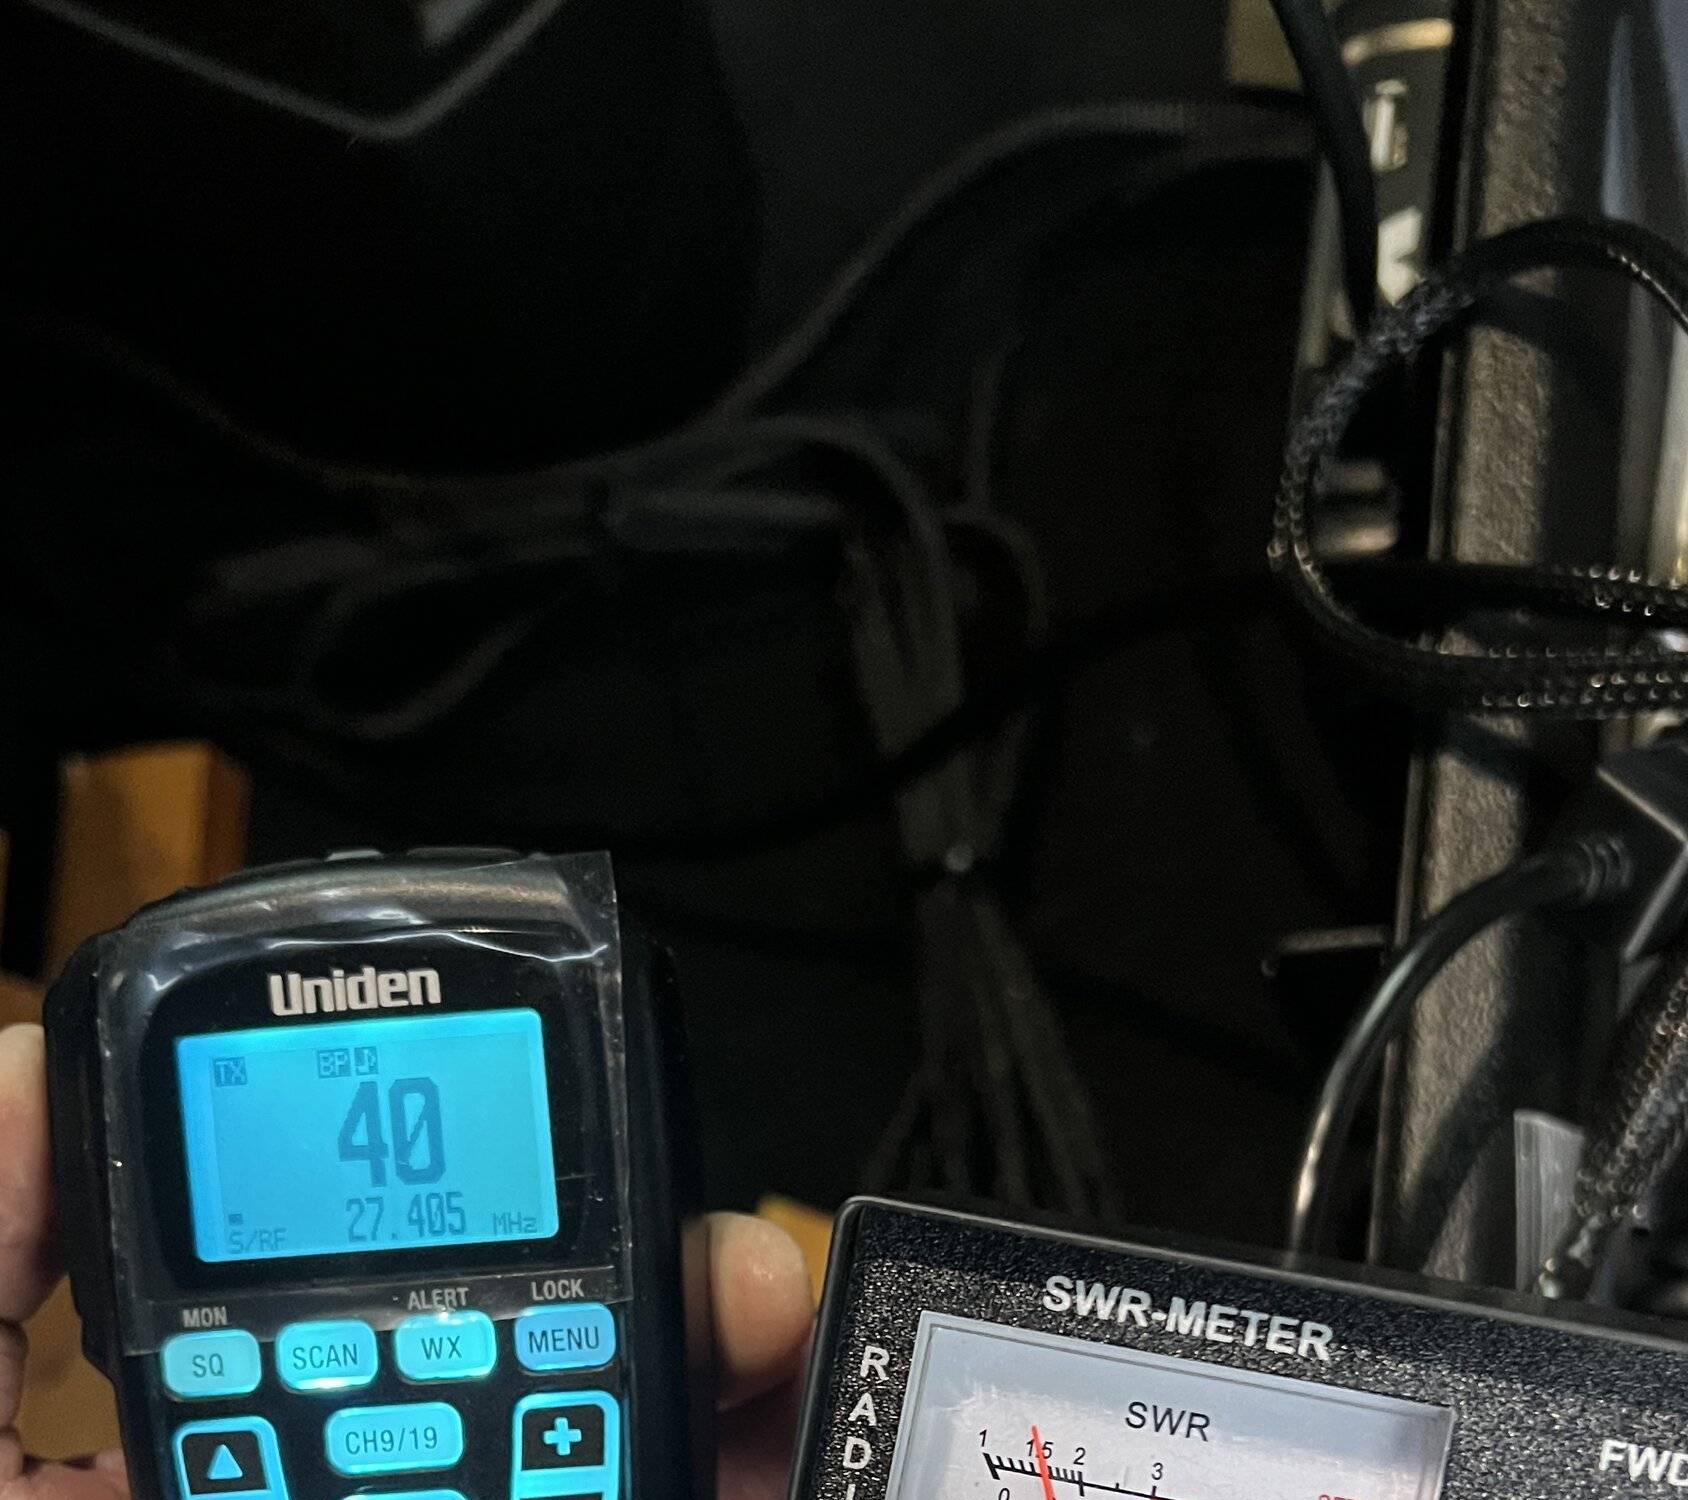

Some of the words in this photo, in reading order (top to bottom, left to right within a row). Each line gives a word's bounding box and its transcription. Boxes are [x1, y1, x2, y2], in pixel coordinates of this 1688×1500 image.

[268, 966, 442, 1017] Uniden
[214, 1059, 247, 1087] TX
[318, 1050, 350, 1078] BP
[337, 1076, 446, 1188] 40
[345, 1191, 467, 1244] 27.405
[492, 1212, 539, 1236] MHz
[228, 1227, 287, 1255] S/RF
[407, 1287, 469, 1312] ALERT
[531, 1278, 585, 1301] LOCK
[182, 1305, 228, 1329] MON
[1043, 1275, 1335, 1362] SWR-METER
[420, 1336, 463, 1361] WX
[527, 1327, 601, 1354] MENU
[192, 1352, 225, 1379] SQ
[292, 1342, 359, 1371] SCAN
[1125, 1401, 1212, 1442] SWR
[345, 1426, 439, 1455] CH9/19
[979, 1429, 988, 1448] 1
[1073, 1446, 1086, 1466] 2
[1151, 1462, 1164, 1481] 3
[1599, 1439, 1688, 1486] FWD
